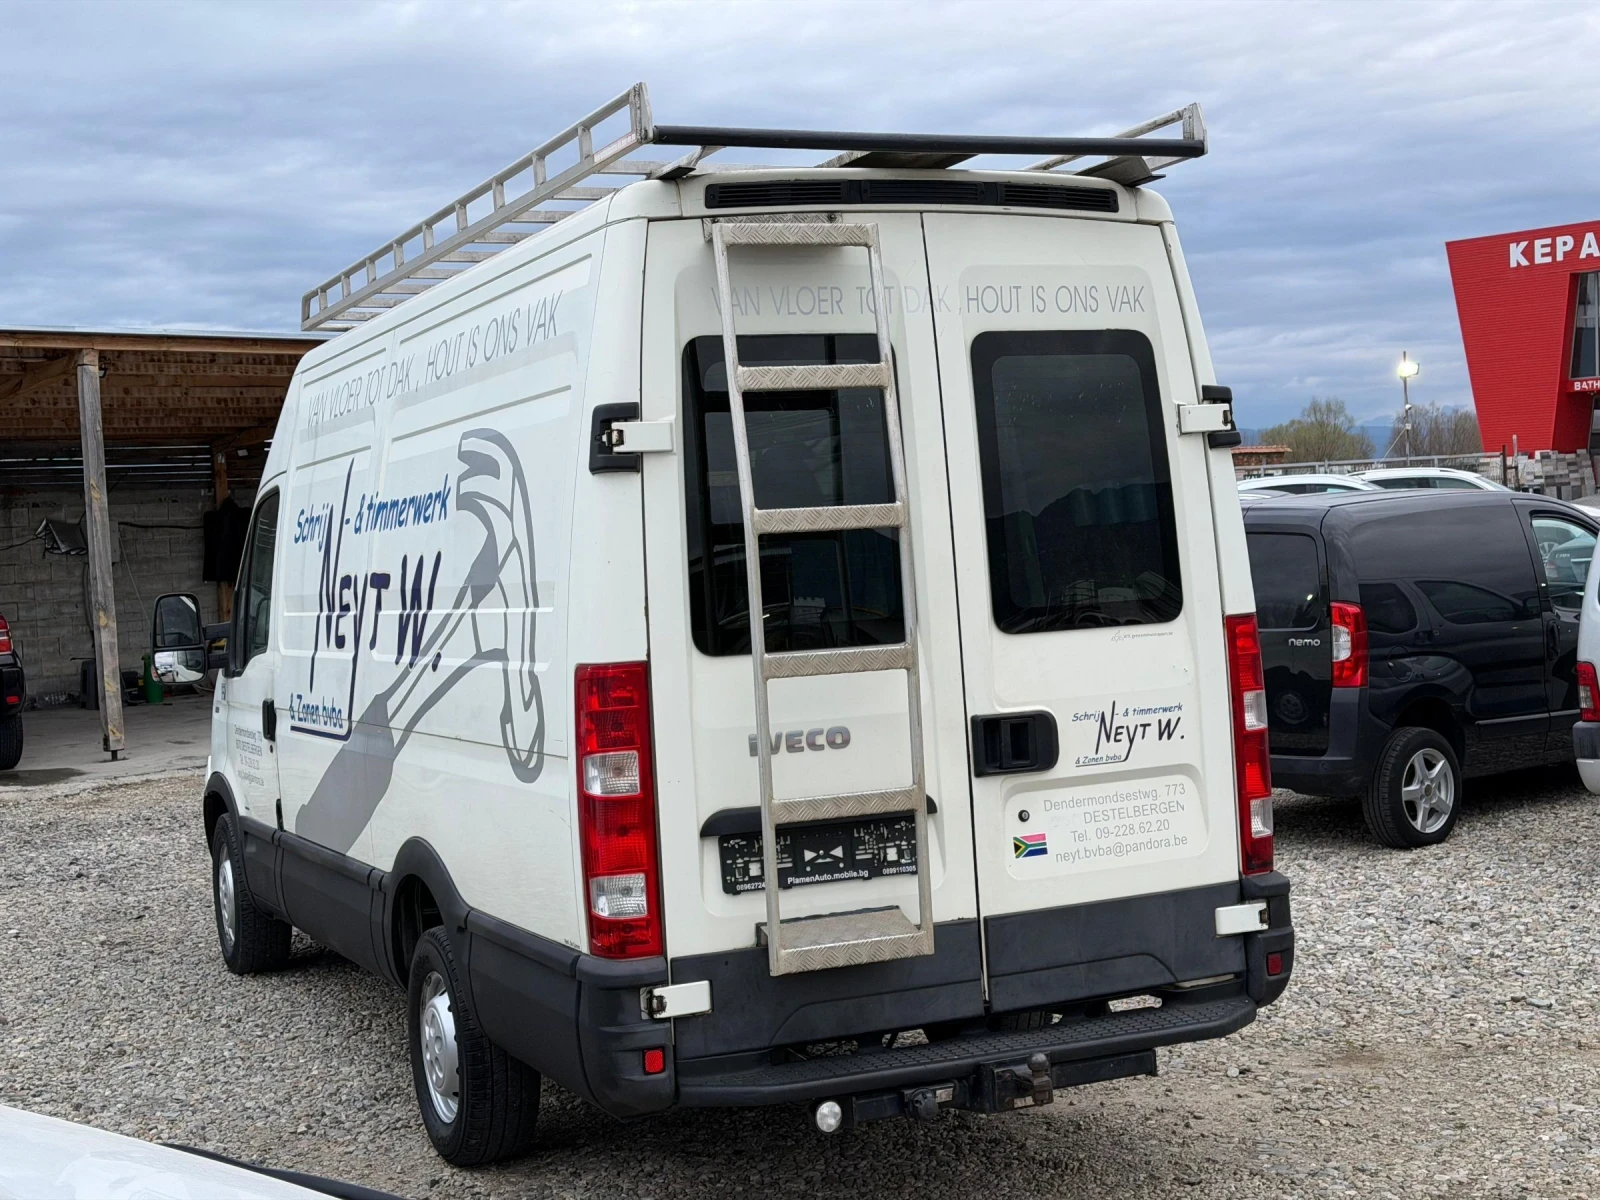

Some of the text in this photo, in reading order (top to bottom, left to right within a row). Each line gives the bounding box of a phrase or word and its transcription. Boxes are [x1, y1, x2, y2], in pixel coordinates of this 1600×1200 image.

[769, 286, 844, 316] VLOER
[966, 285, 1022, 314] HOUT
[1031, 285, 1046, 313] IS
[1055, 285, 1099, 313] ONS
[1106, 285, 1145, 313] VAK
[308, 389, 329, 427] VAN
[329, 376, 363, 420] VLOER
[364, 366, 386, 406] TOT
[425, 331, 465, 384] HOUT
[465, 325, 480, 368] IS
[484, 308, 521, 361] ONS
[527, 289, 563, 347] VAK
[365, 473, 451, 534] timmerwerk
[1288, 638, 1320, 647] nemo
[289, 692, 343, 729] & Zonen bvba
[1123, 708, 1129, 717] &
[1132, 702, 1183, 716] timmerwerk
[748, 726, 851, 757] IVECO
[1158, 717, 1184, 741] W.
[1075, 754, 1121, 765] & Zonen bvba
[1043, 783, 1186, 812] Dendermondsestwg. 773
[1083, 800, 1185, 824] DESTELBERGEN
[1071, 829, 1091, 843] Tel.
[1096, 819, 1170, 840] 09-228.62.20
[1056, 834, 1188, 863] neyt.bvba@pandora.be
[787, 870, 869, 884] PlamenAuto.mobile.bg
